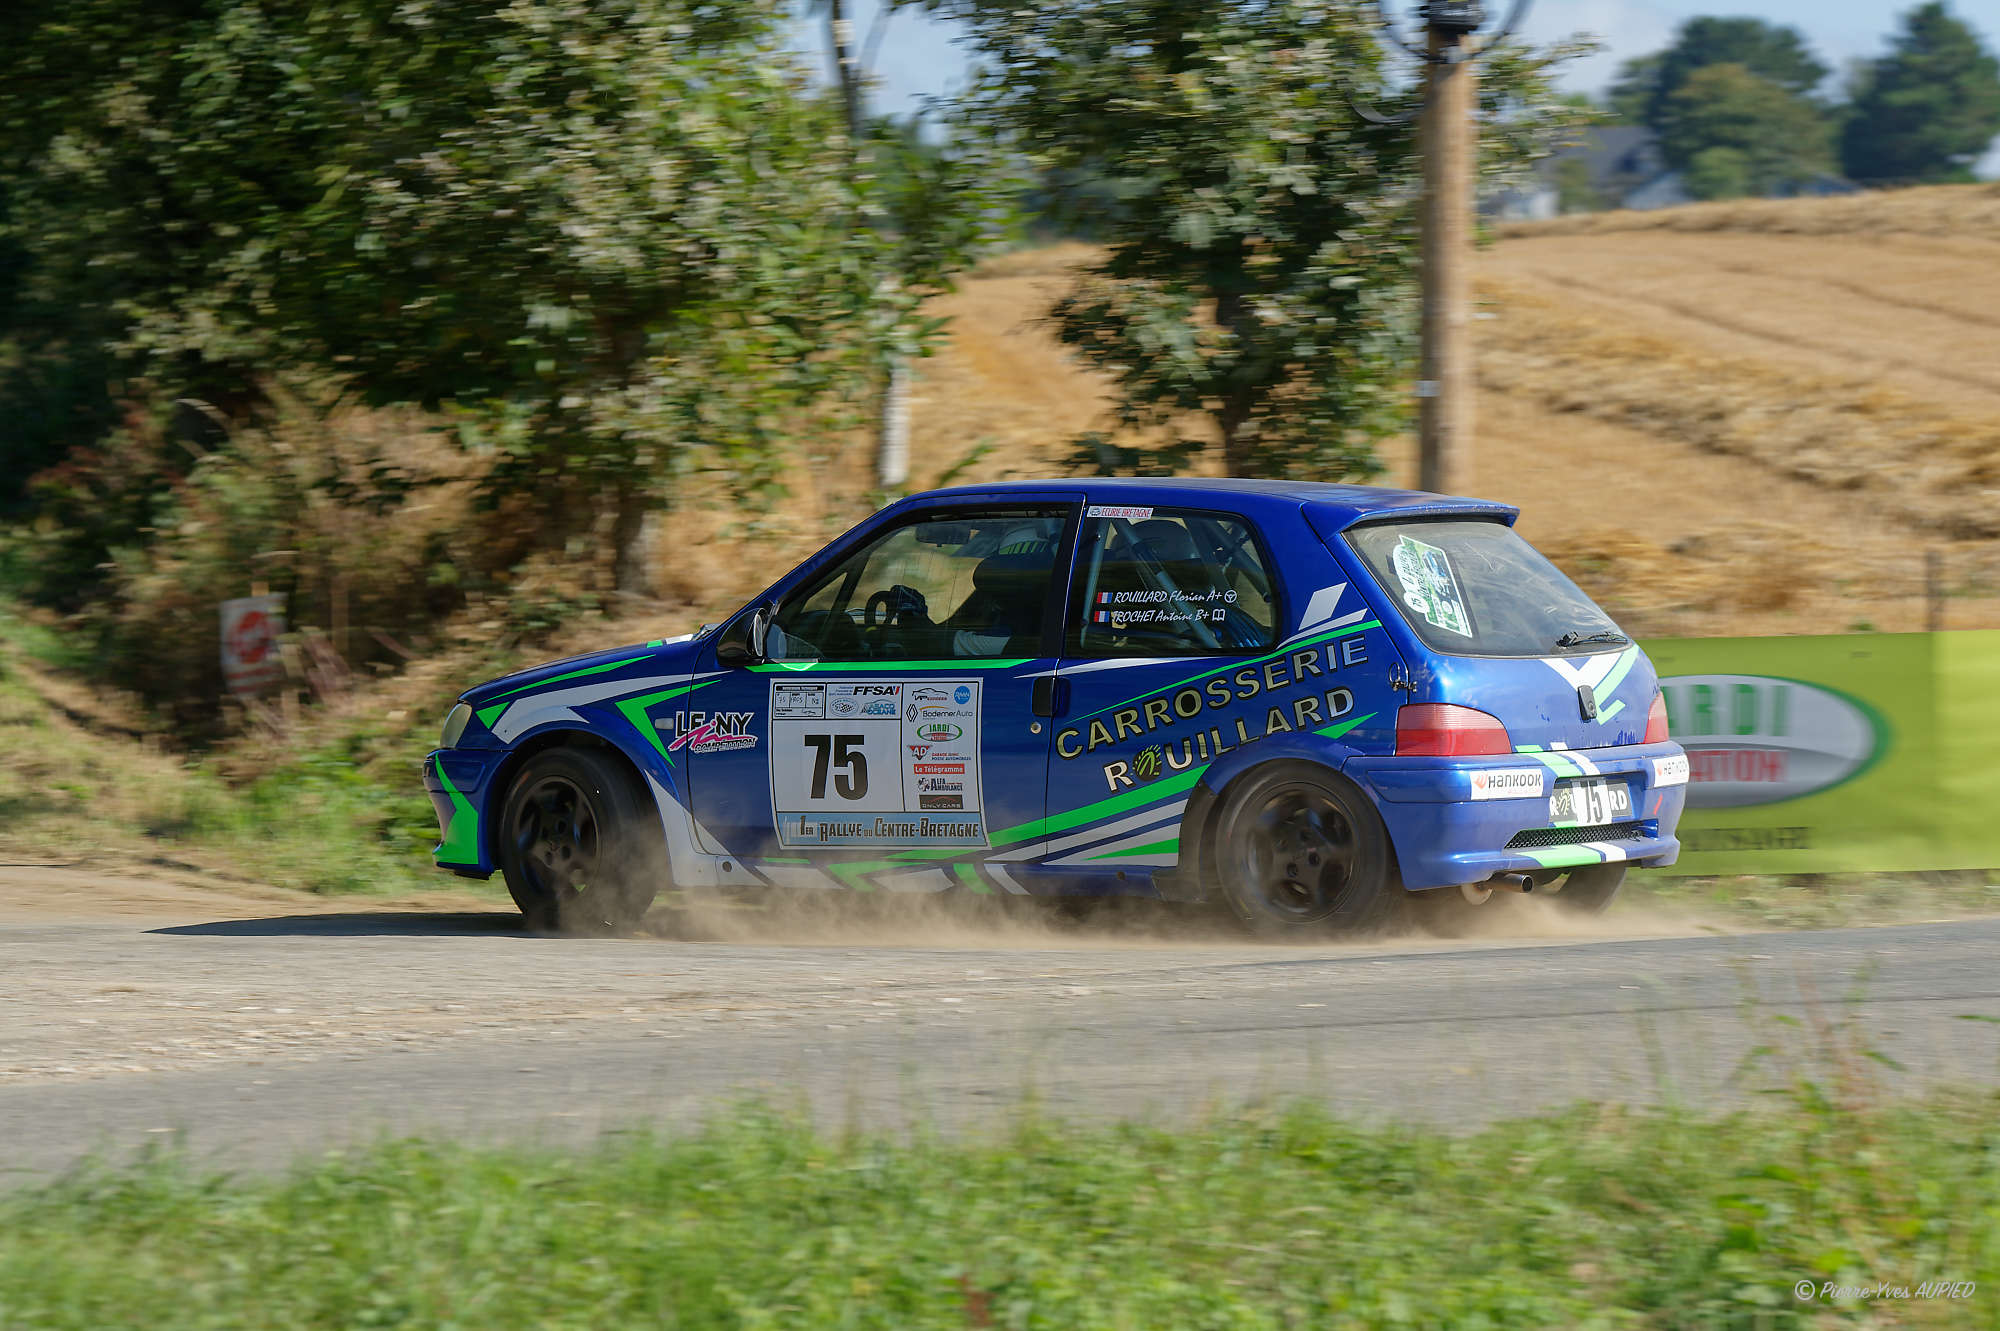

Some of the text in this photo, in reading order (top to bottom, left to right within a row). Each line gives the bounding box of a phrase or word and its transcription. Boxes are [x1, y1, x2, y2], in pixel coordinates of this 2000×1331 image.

[1114, 589, 1223, 604] ROUILLARD Florian A+
[1112, 608, 1209, 623] TROCHET Antoine B+
[853, 686, 895, 696] FFSA
[1055, 635, 1369, 760] CARROSSERIE
[913, 747, 928, 756] AD
[804, 735, 869, 801] 75
[820, 822, 862, 841] RALLYE
